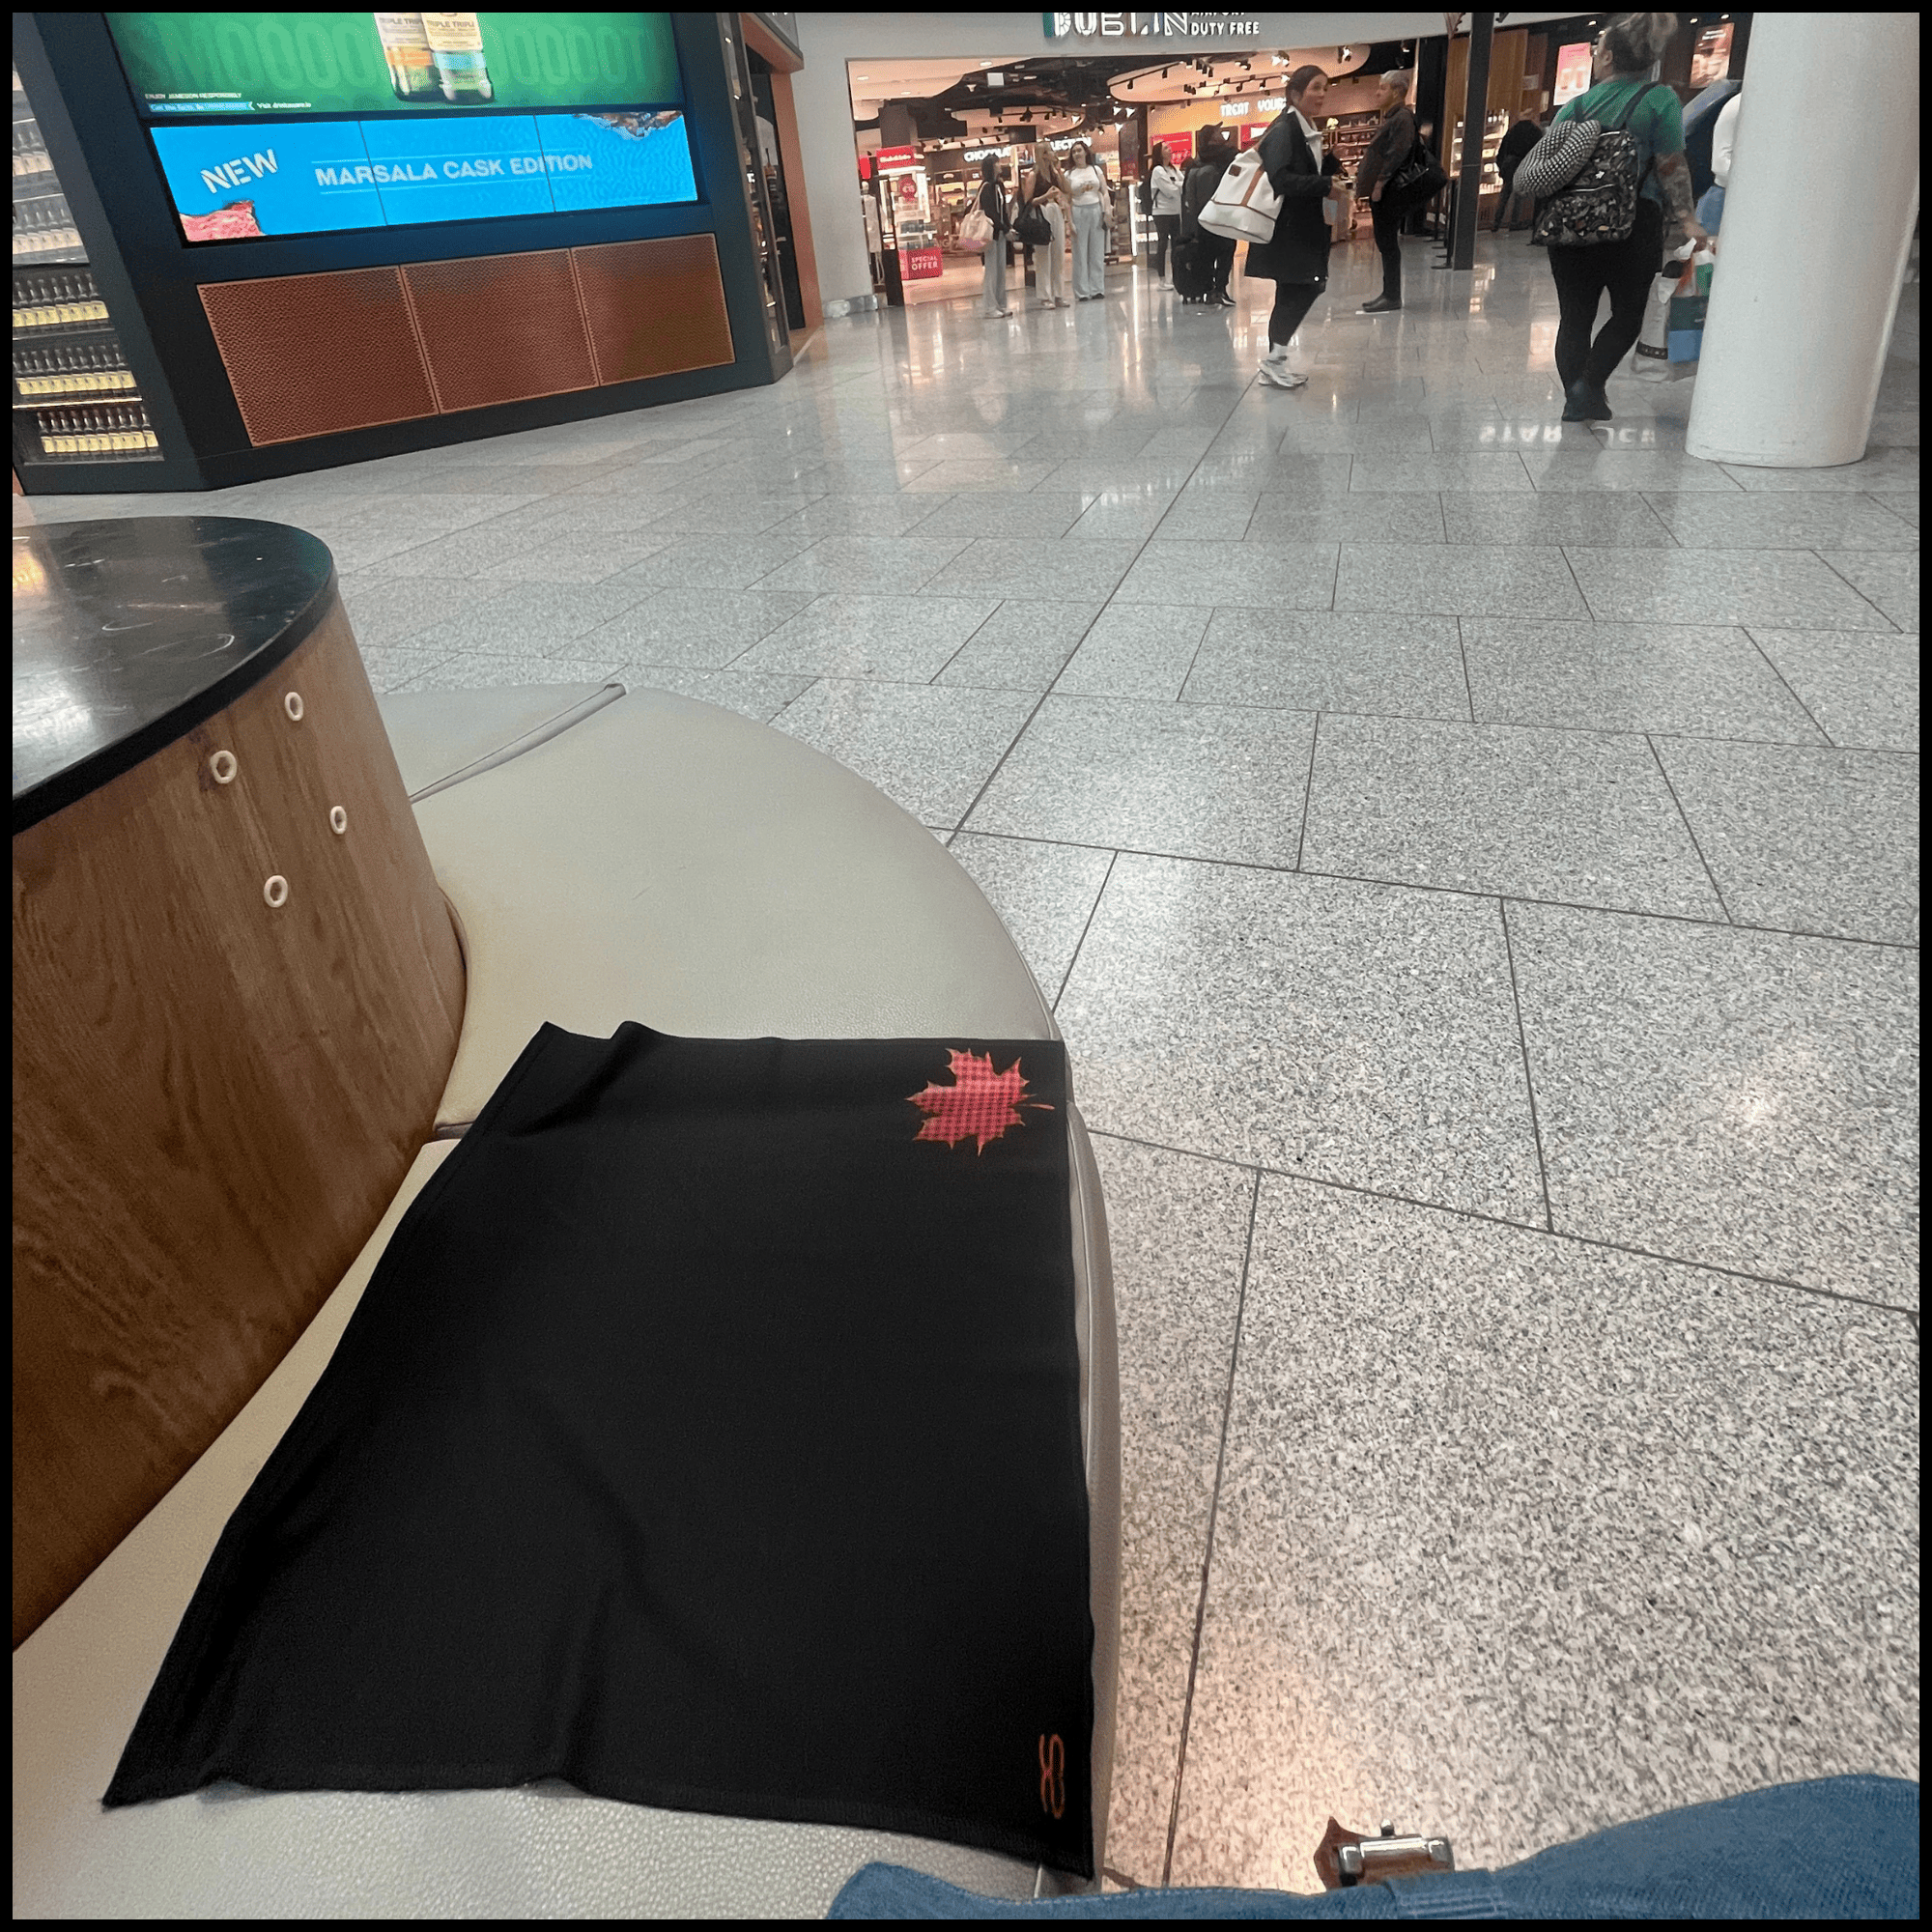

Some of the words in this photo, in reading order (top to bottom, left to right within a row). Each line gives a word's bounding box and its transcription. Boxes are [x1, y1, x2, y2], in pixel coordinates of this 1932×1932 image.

[1054, 13, 1188, 36] DUBLIN
[1191, 22, 1224, 36] DUTY
[1229, 21, 1260, 35] FREE
[1221, 101, 1250, 117] TREAT
[200, 148, 278, 194] NEW
[315, 163, 439, 186] MARSALA
[442, 158, 504, 180] CASK
[509, 154, 593, 176] EDITION
[911, 255, 938, 264] SPECIAL
[911, 262, 938, 271] OFFER
